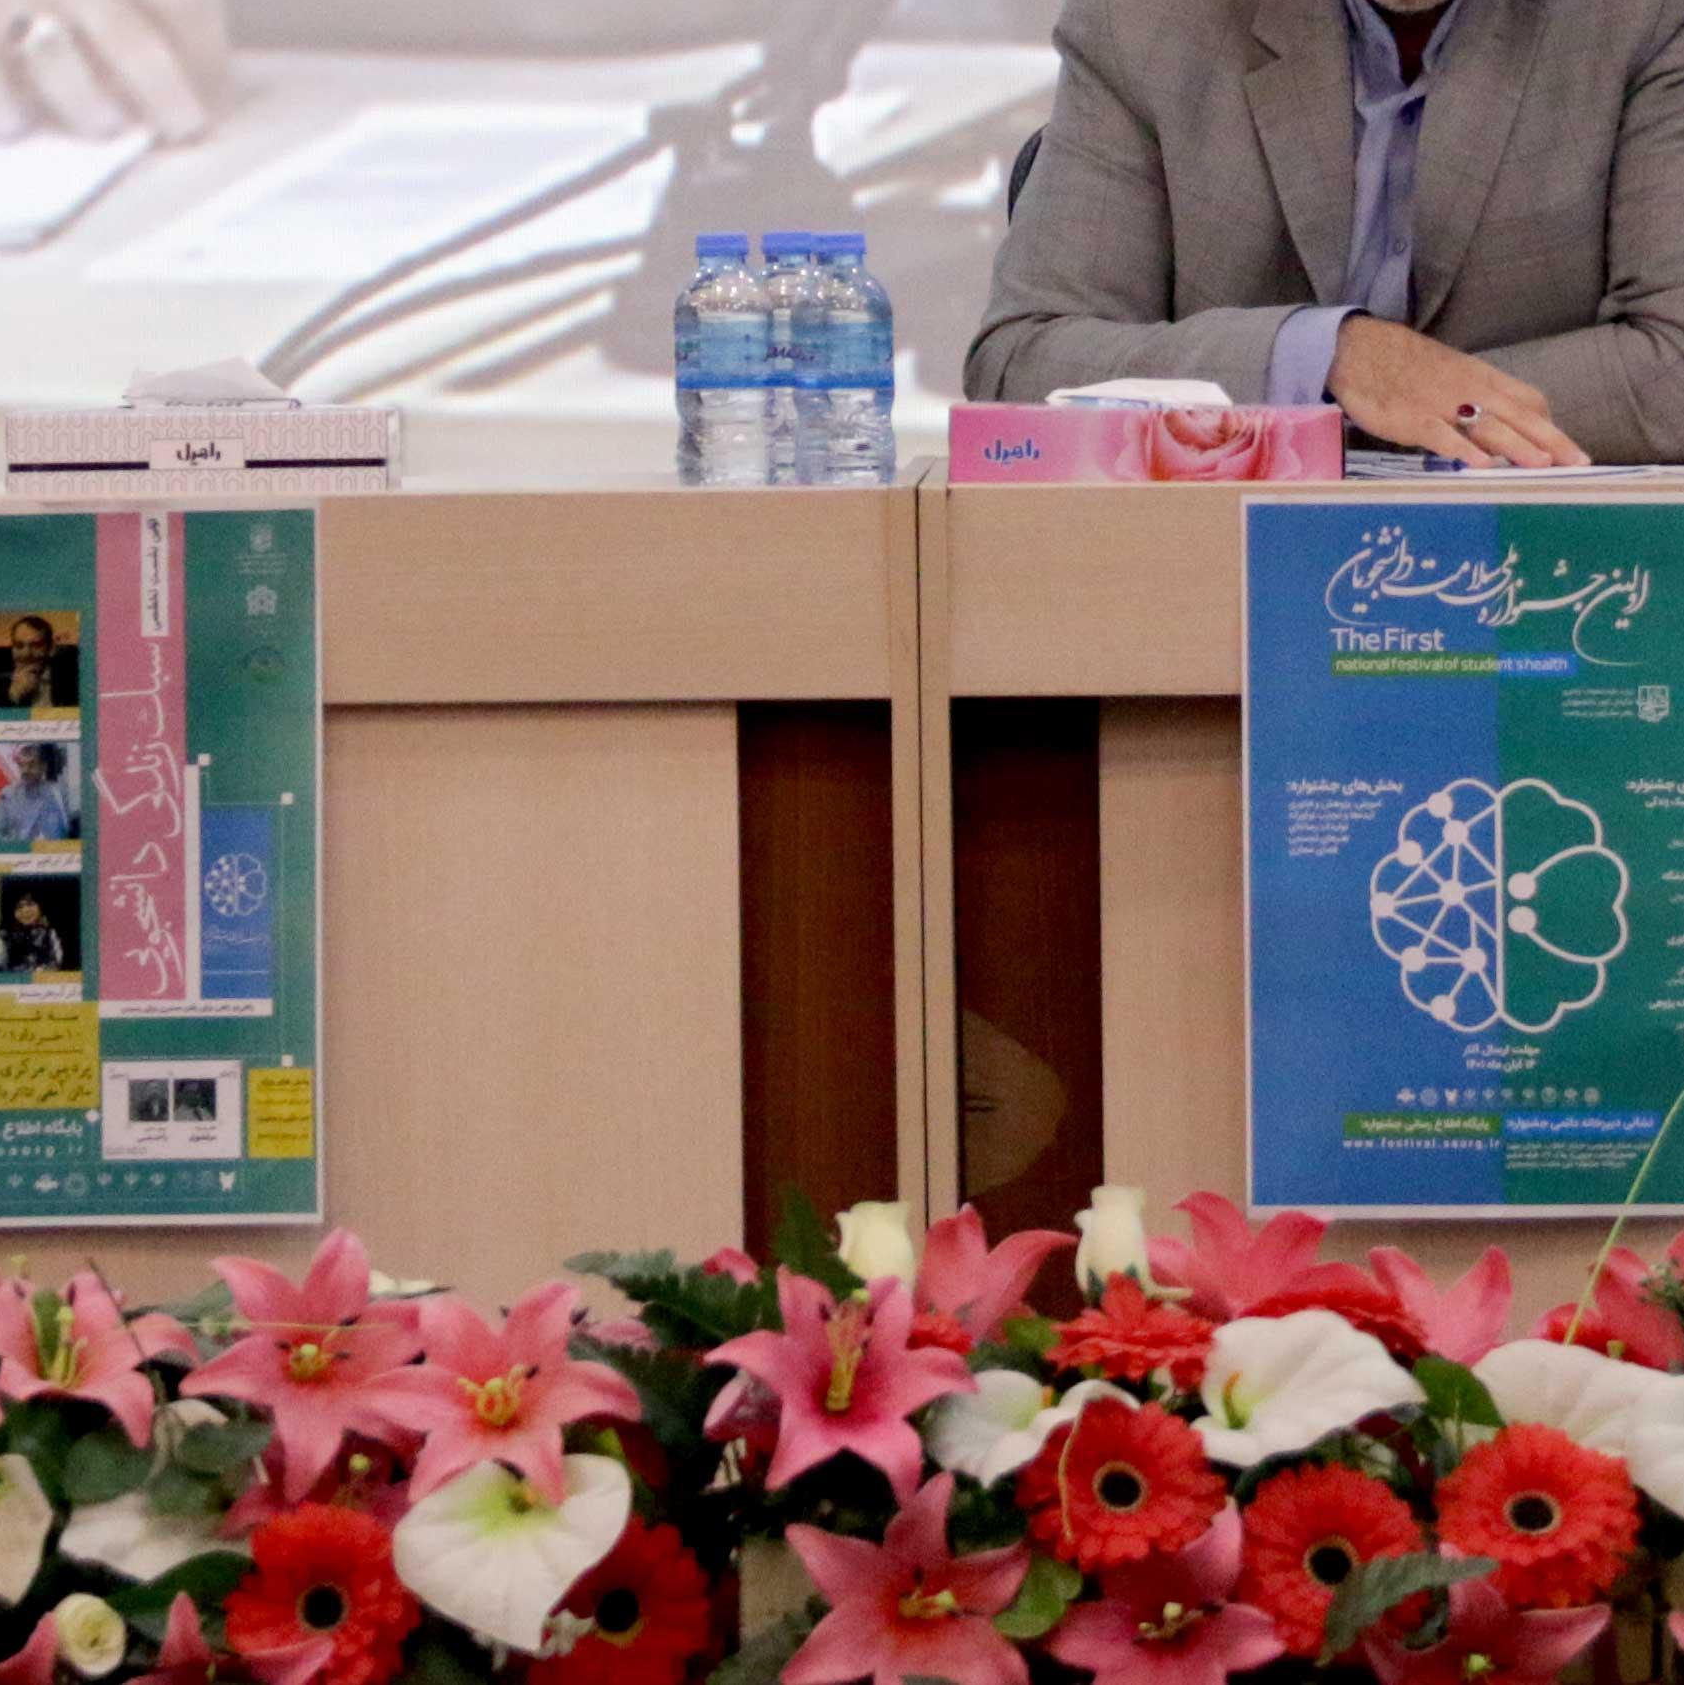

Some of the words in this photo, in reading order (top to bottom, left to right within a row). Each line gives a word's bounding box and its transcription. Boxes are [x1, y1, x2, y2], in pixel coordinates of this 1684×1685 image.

[1330, 628, 1381, 651] The
[1385, 628, 1445, 651] First
[1336, 656, 1389, 671] national
[91, 742, 181, 838] زندگی
[109, 841, 185, 996] دانشجویی
[3, 1121, 42, 1141] اطلاع
